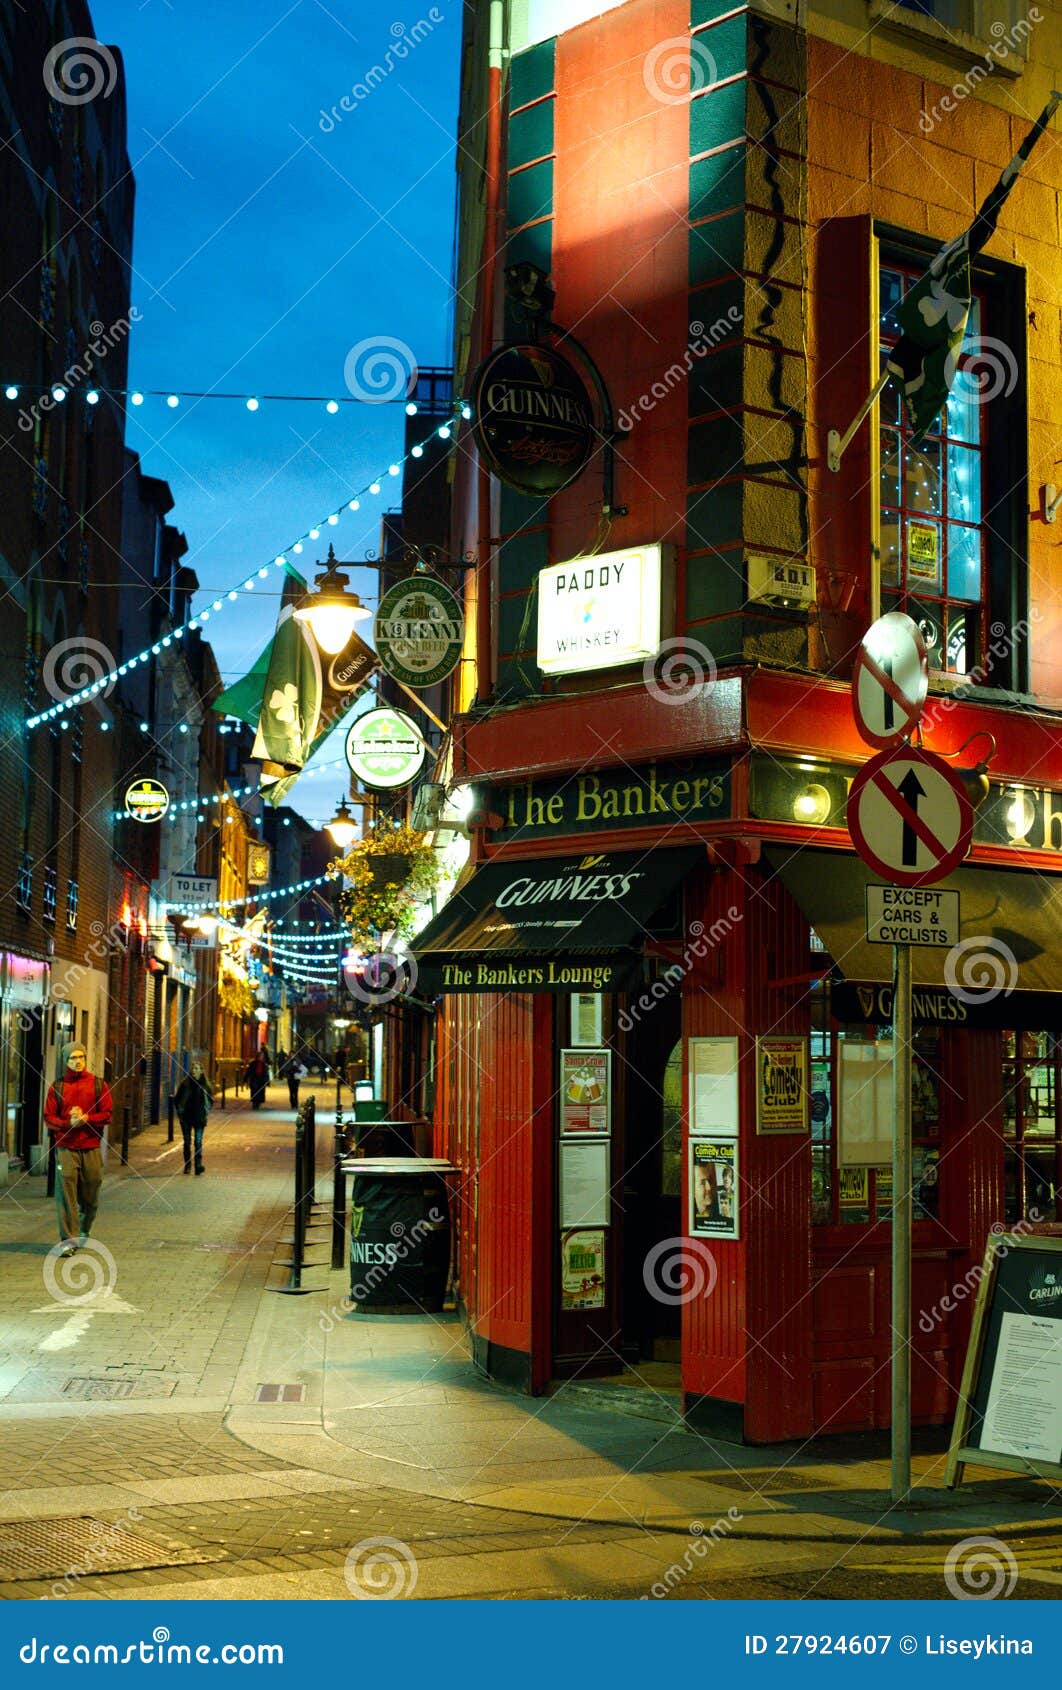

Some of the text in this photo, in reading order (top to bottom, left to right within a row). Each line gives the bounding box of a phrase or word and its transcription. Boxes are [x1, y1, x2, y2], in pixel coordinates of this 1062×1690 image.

[556, 562, 626, 595] PADDY
[556, 629, 622, 654] WHISKEY
[504, 766, 724, 827] The Bankers
[177, 880, 212, 893] TO LET
[495, 873, 641, 908] GUINNESS
[883, 889, 943, 908] EXCEPT
[883, 908, 939, 925] CARS &
[880, 926, 948, 943] CYCLISTS
[442, 961, 612, 989] The Bankers Lounge
[878, 987, 967, 1021] GNNESS
[1029, 1285, 1062, 1301] CARLIN
